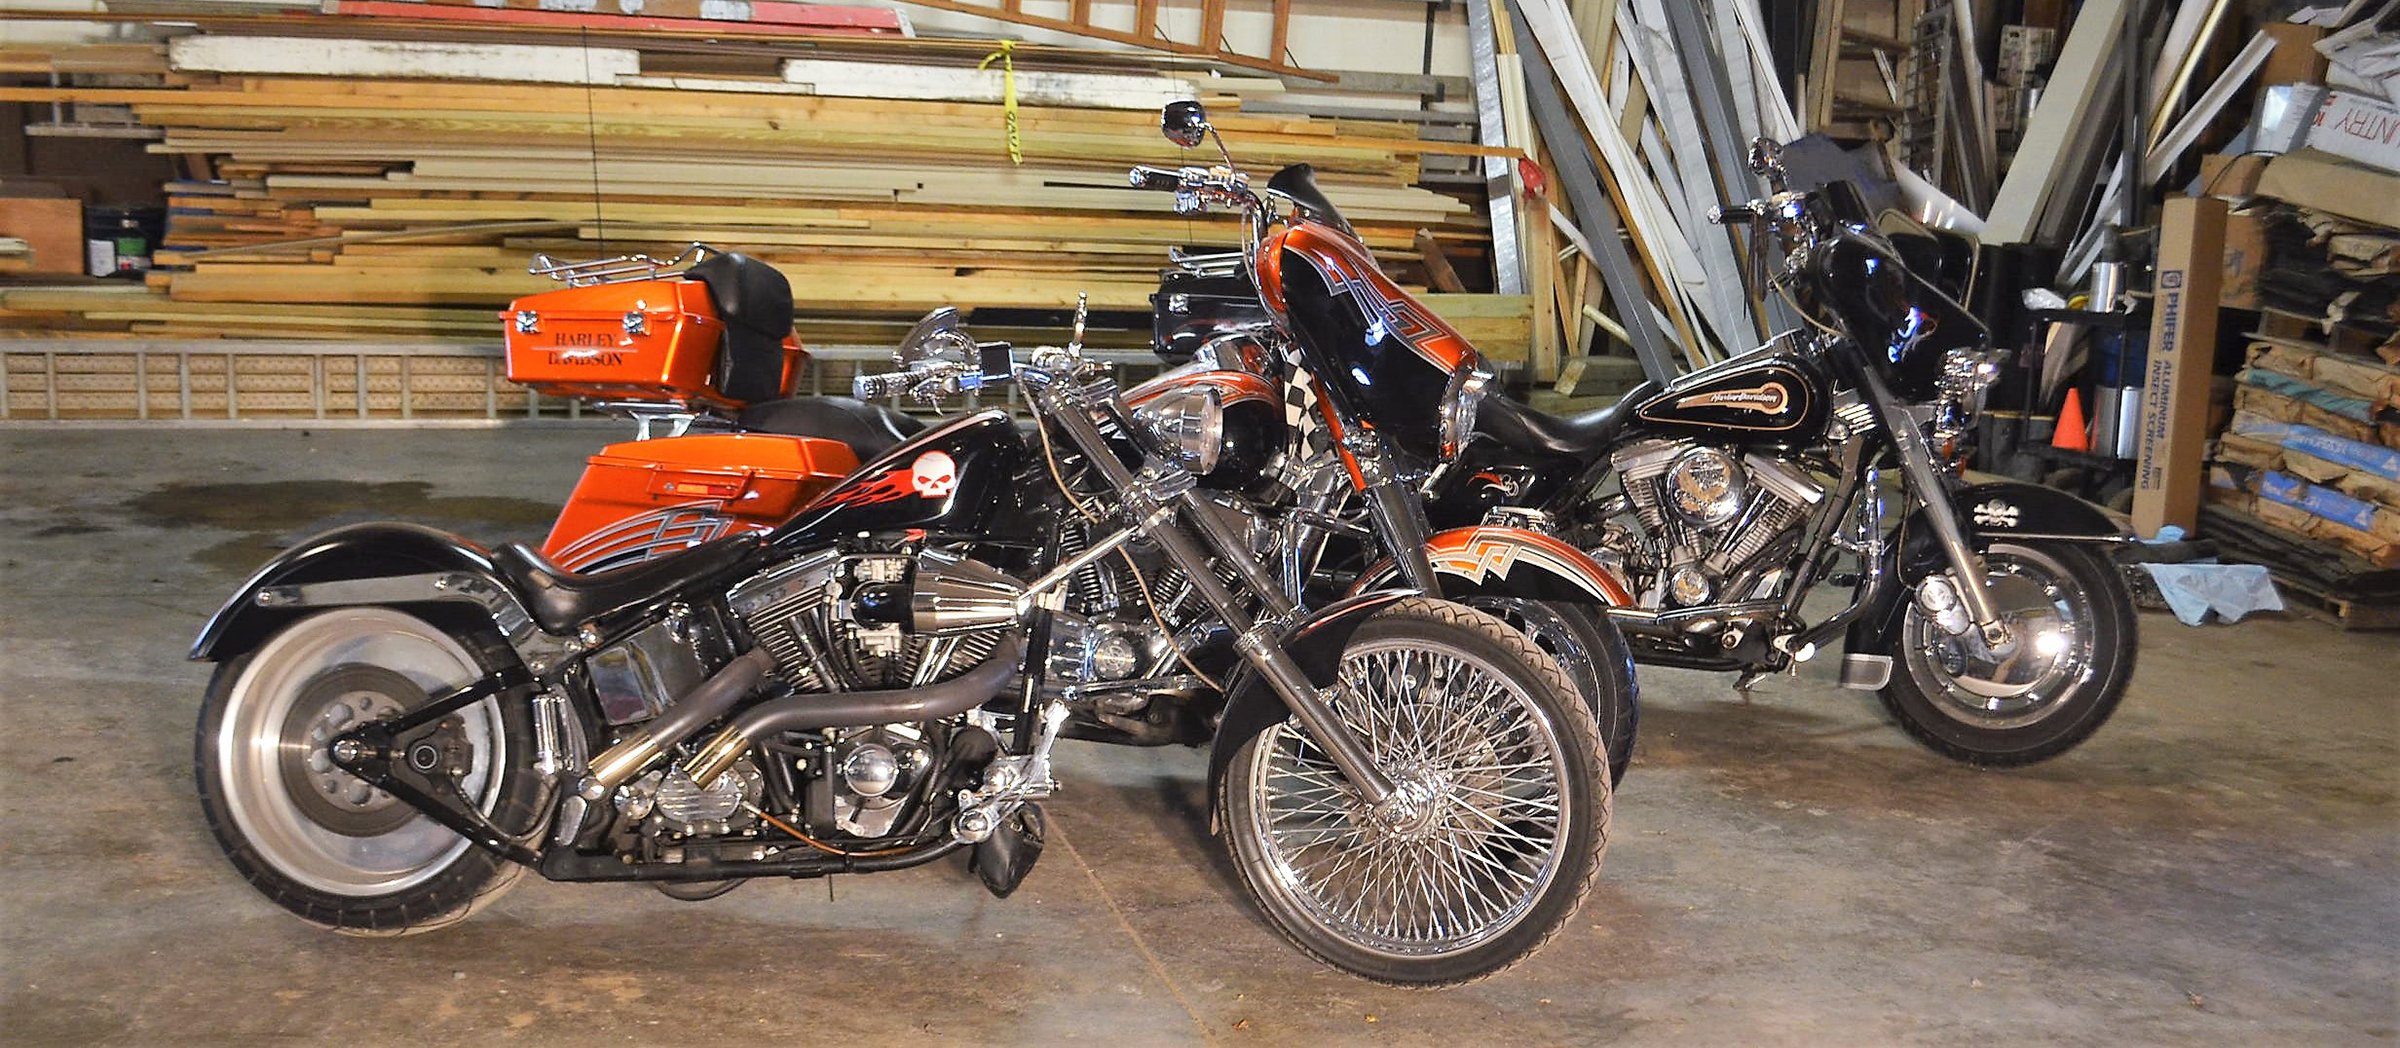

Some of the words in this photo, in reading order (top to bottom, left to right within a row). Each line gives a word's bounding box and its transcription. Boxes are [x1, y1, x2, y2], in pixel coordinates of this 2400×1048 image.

[555, 333, 616, 347] HARLEY
[2162, 292, 2179, 352] PHIFER
[2150, 360, 2162, 407] INSECT
[2156, 360, 2172, 439] ALUMINUM
[2141, 411, 2156, 490] SCREENING
